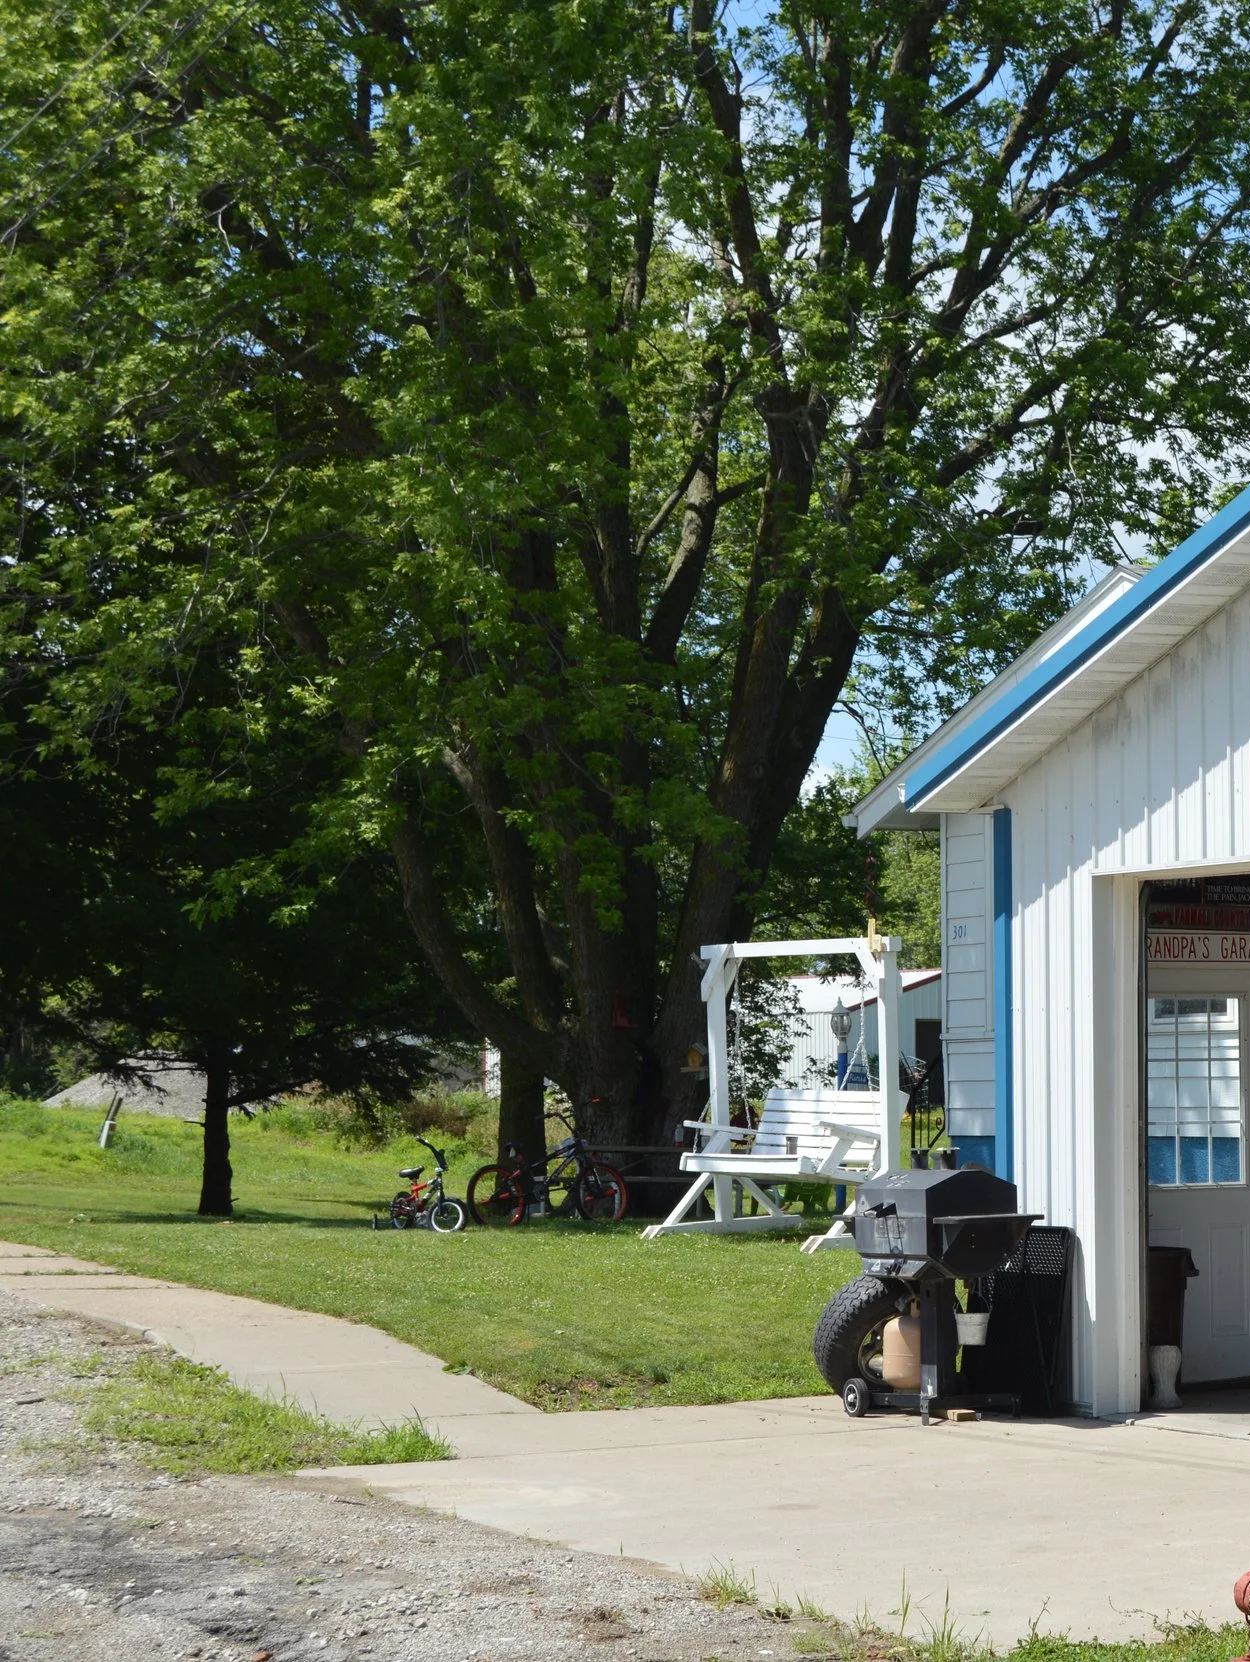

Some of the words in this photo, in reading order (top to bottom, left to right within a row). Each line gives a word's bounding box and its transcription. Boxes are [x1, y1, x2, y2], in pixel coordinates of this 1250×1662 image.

[1207, 893, 1221, 901] THE
[1224, 885, 1233, 893] TO
[1213, 909, 1250, 928] COUNTRY
[952, 924, 967, 940] 301
[1147, 936, 1210, 959] RANDPA'S
